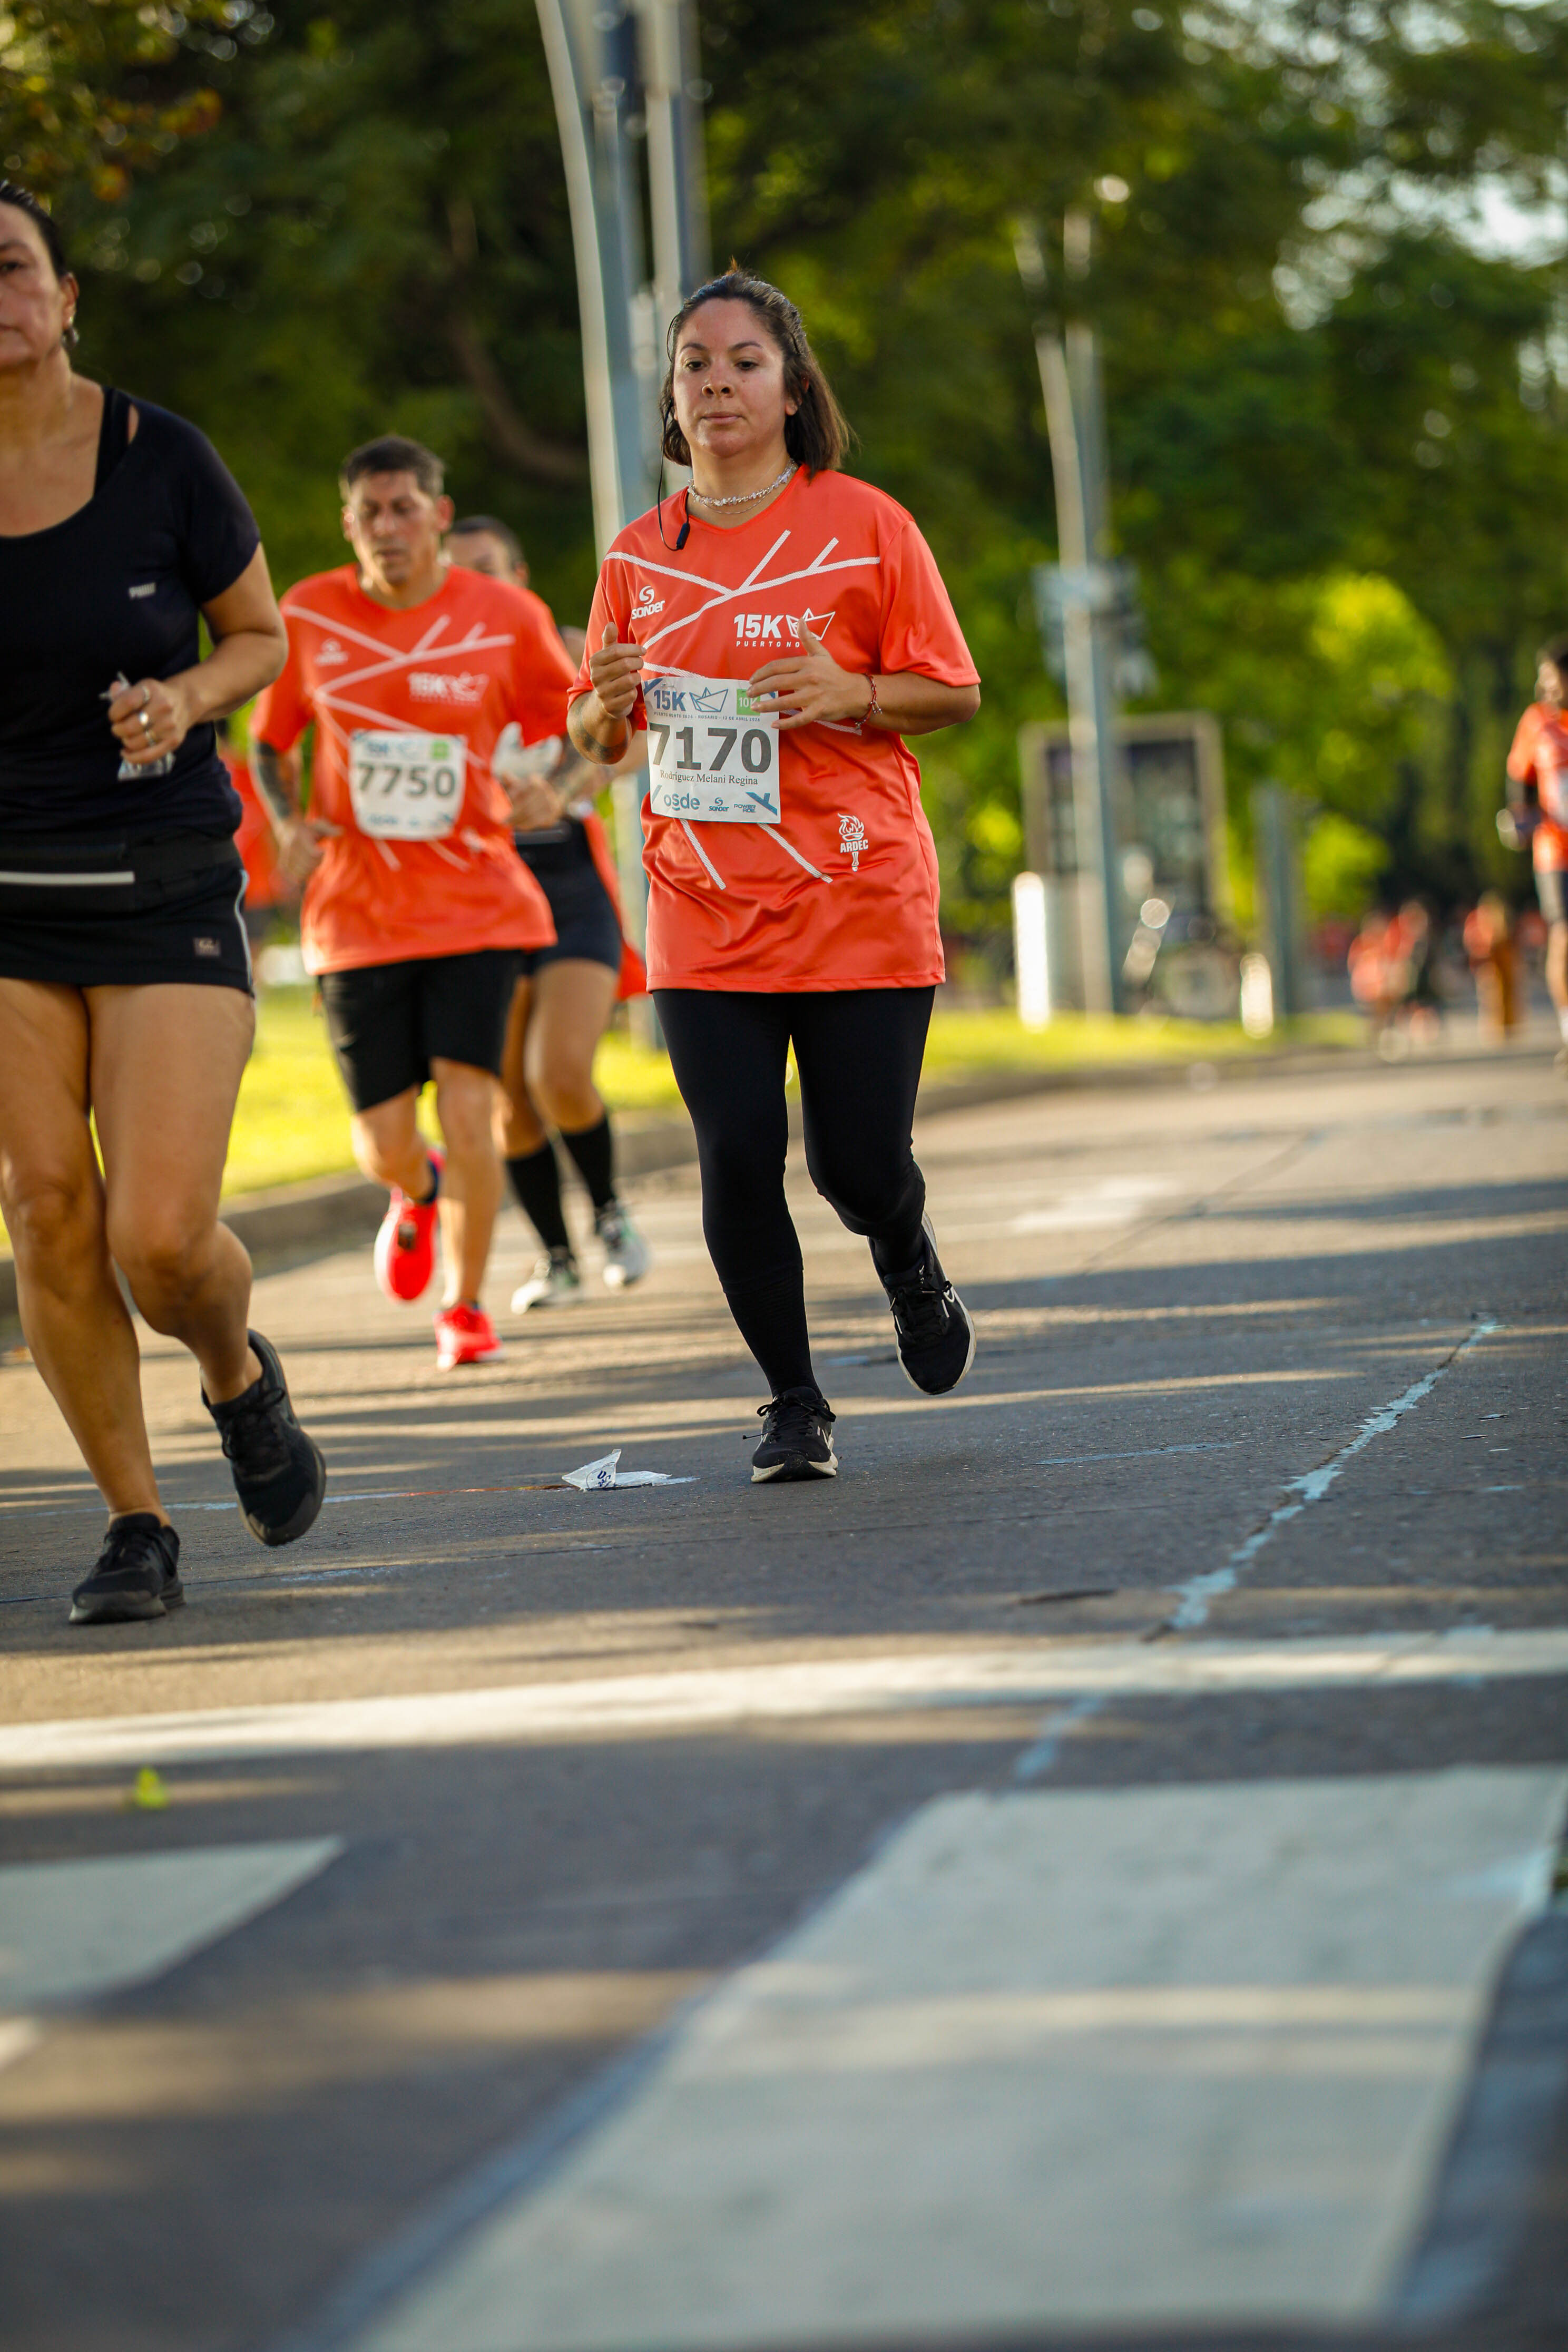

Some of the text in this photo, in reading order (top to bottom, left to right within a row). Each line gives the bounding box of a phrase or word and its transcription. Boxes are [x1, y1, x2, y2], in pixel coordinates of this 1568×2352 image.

[733, 613, 785, 639] 15K
[653, 689, 686, 712] 15K
[649, 722, 772, 773] 7170
[357, 763, 456, 799] 7750
[660, 769, 759, 787] Rodríguez Melani Regina
[663, 792, 701, 811] osde
[840, 839, 869, 854] ARDEC
